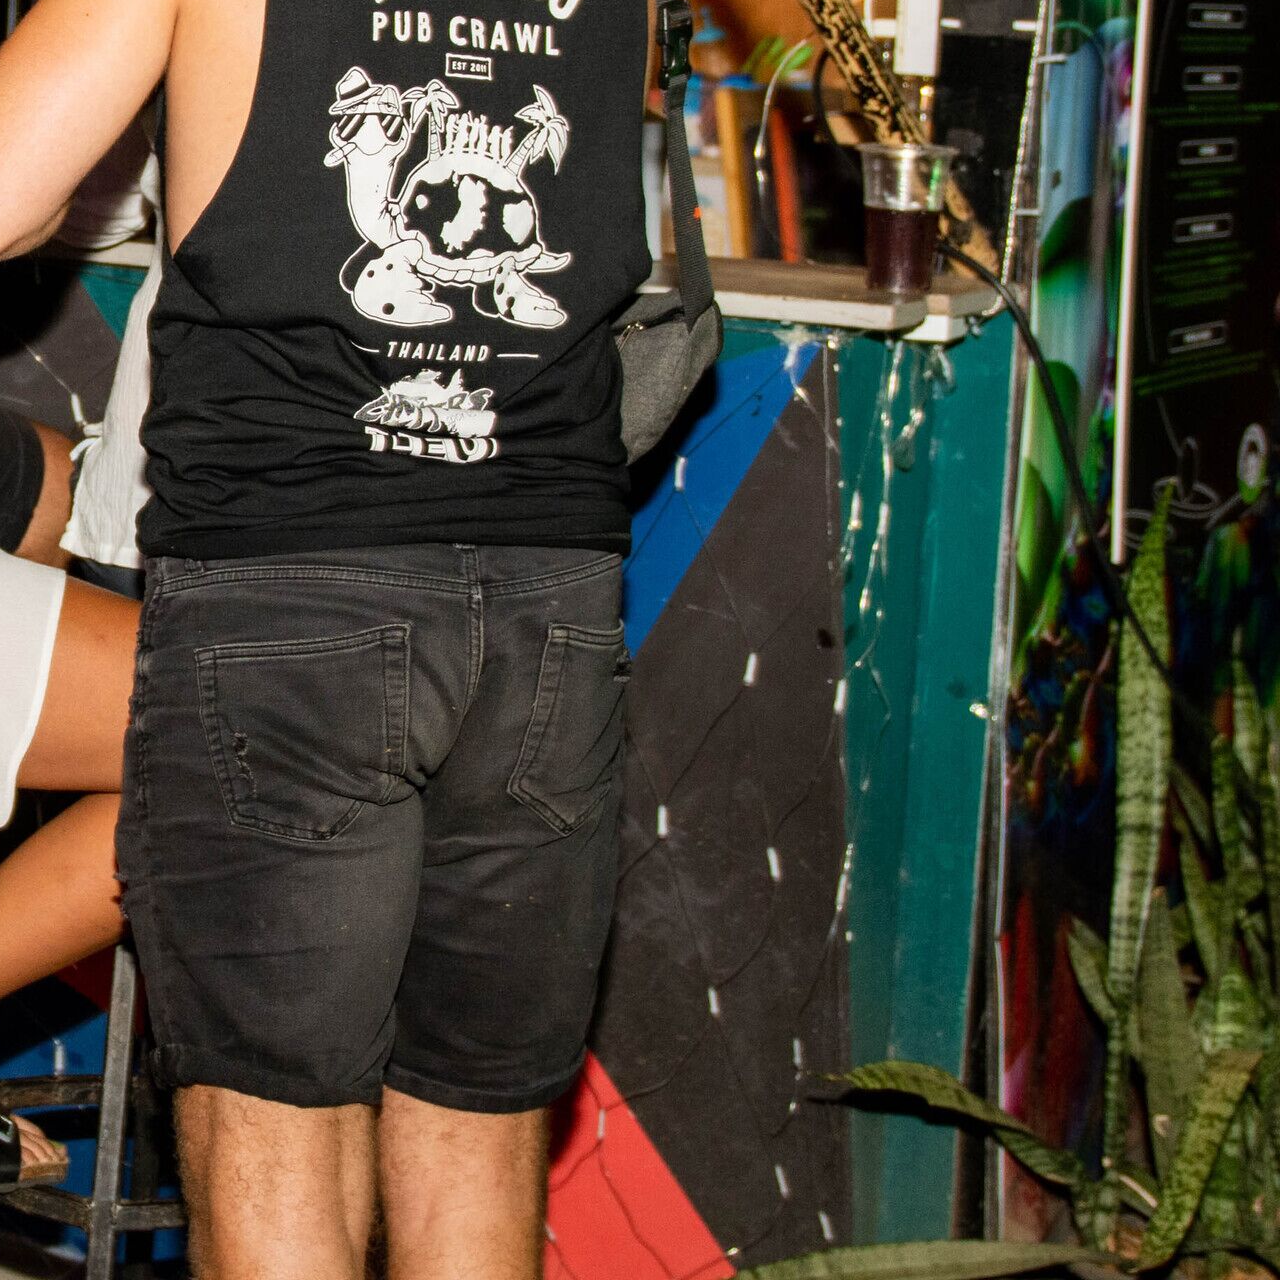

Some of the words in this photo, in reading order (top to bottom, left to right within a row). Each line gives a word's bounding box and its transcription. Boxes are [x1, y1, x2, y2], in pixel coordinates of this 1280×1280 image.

[372, 11, 431, 43] PUB
[449, 16, 560, 56] CRAWL
[452, 61, 467, 70] EST
[387, 341, 490, 362] THAILAND
